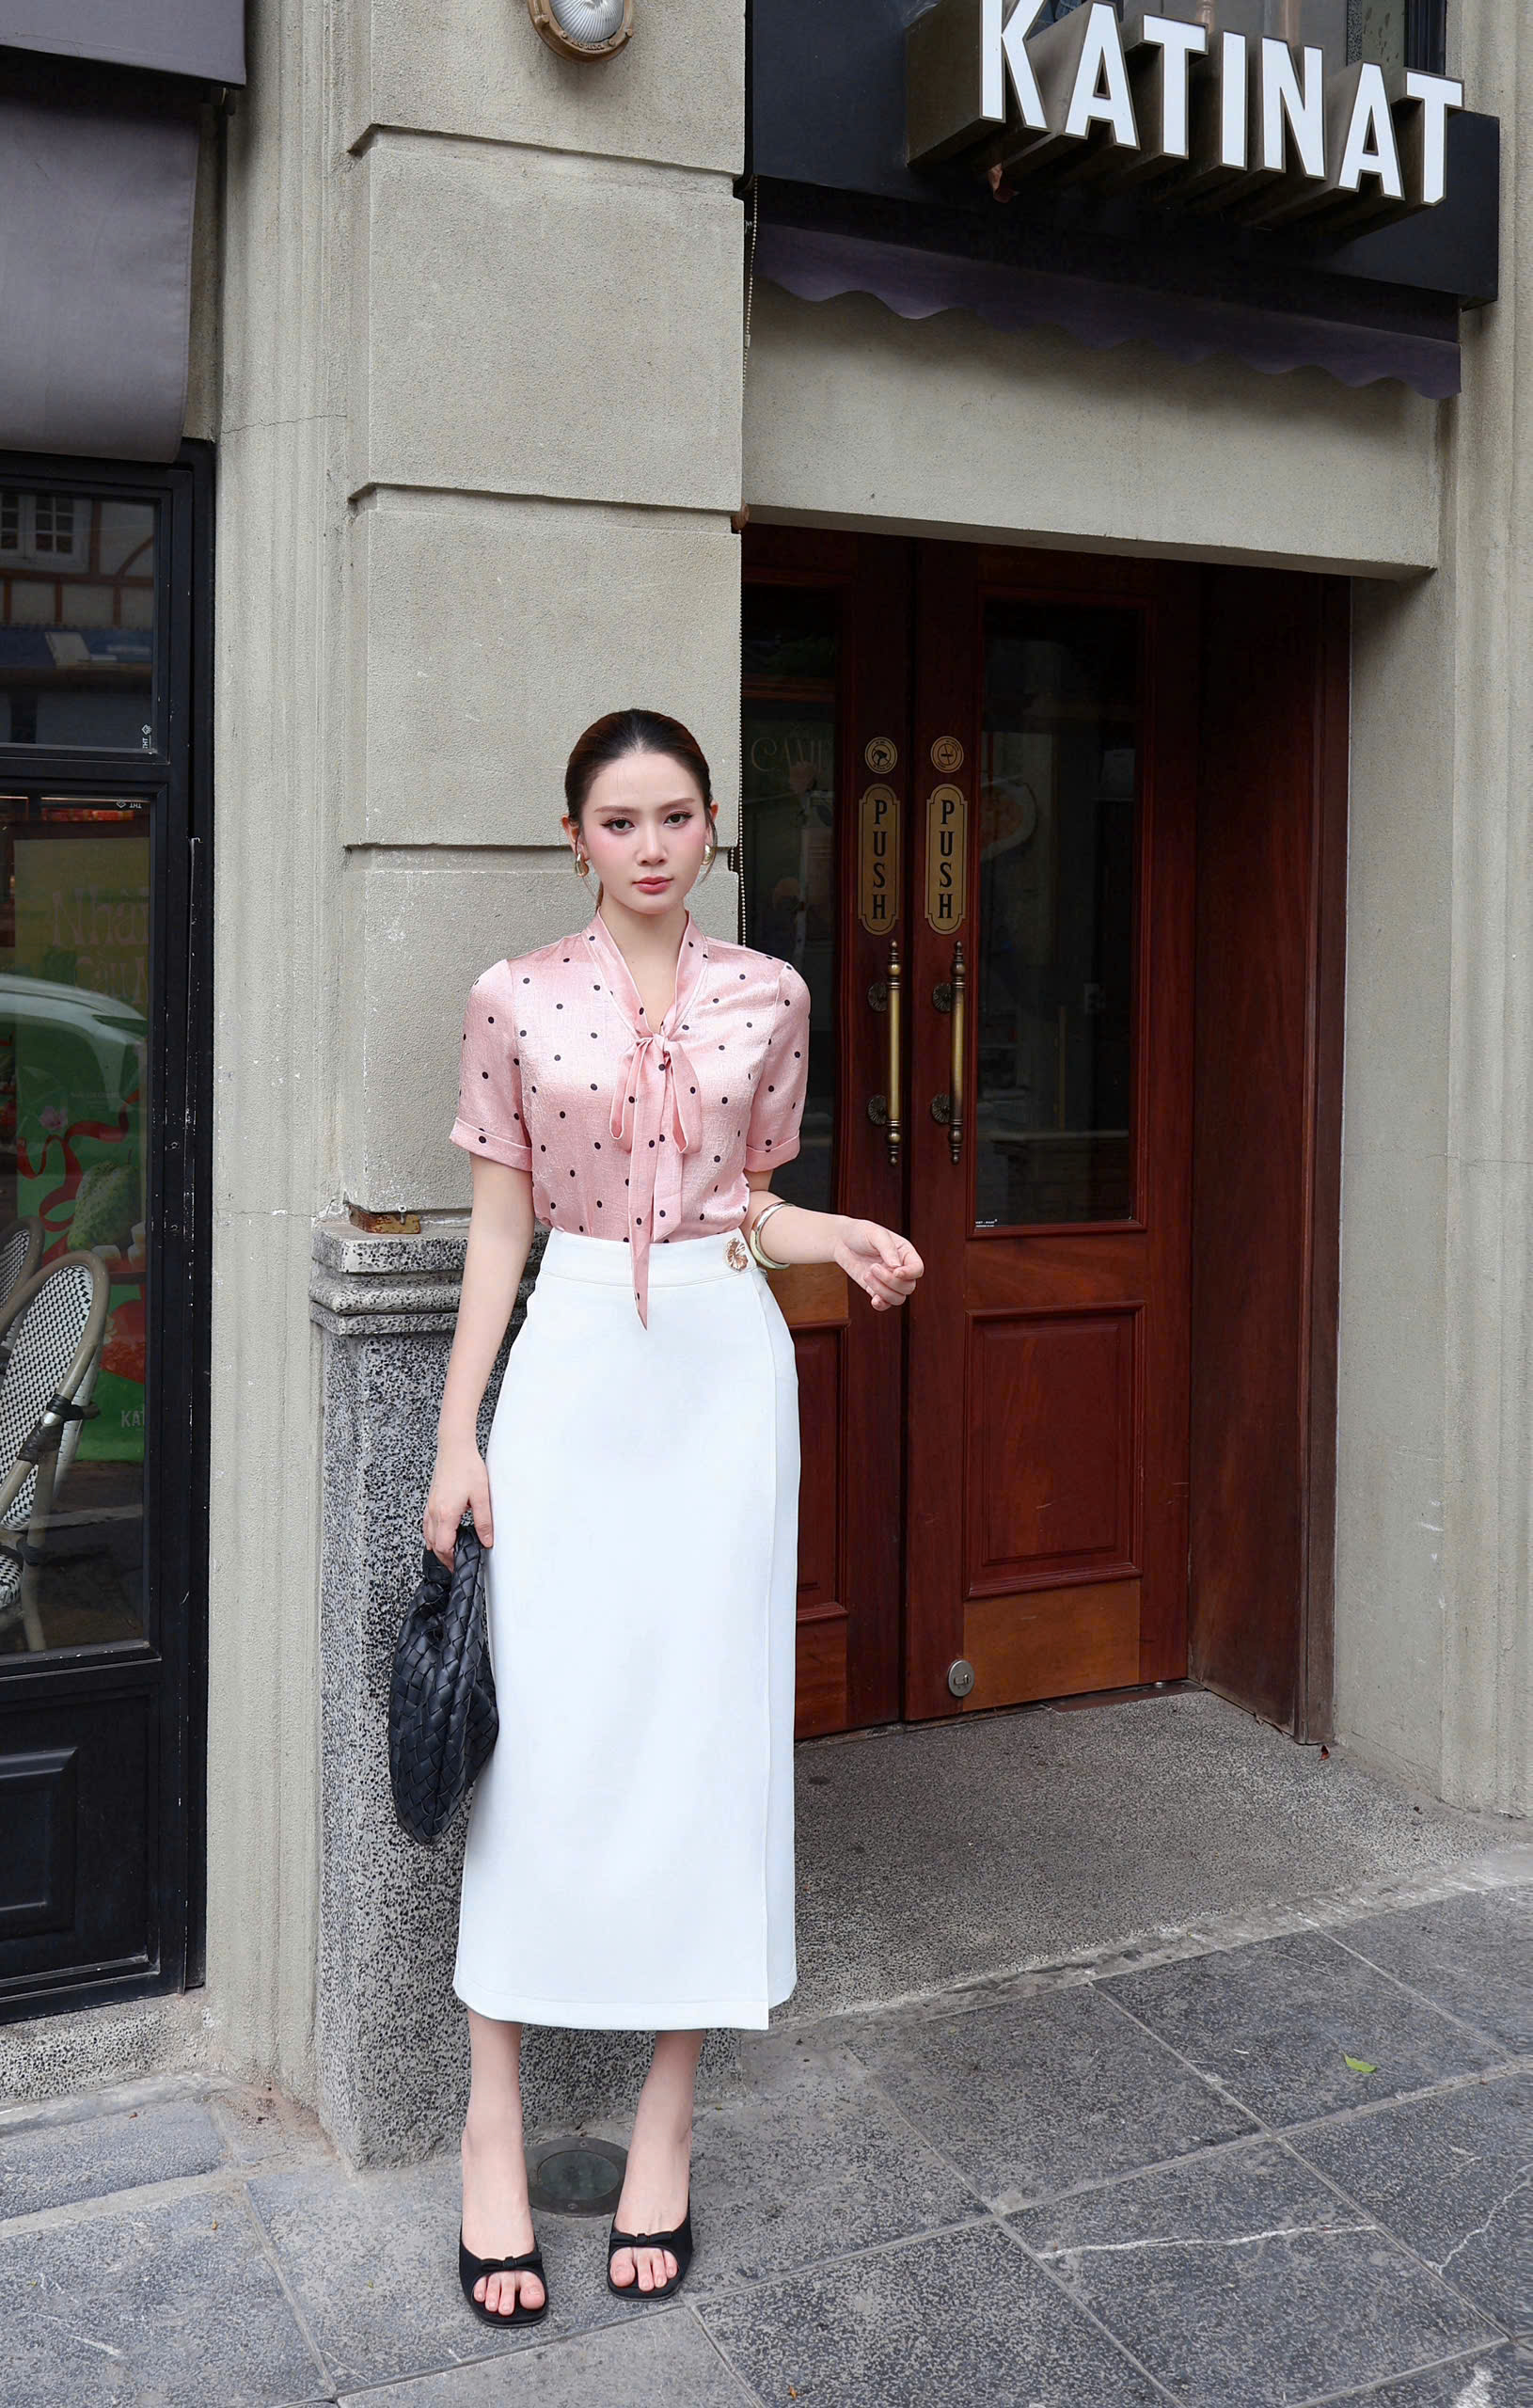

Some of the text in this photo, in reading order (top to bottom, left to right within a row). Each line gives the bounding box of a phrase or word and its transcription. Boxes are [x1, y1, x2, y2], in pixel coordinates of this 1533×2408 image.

[981, 0, 1462, 206] KATINAT
[873, 800, 888, 920] PUSH
[939, 800, 955, 919] PUSH
